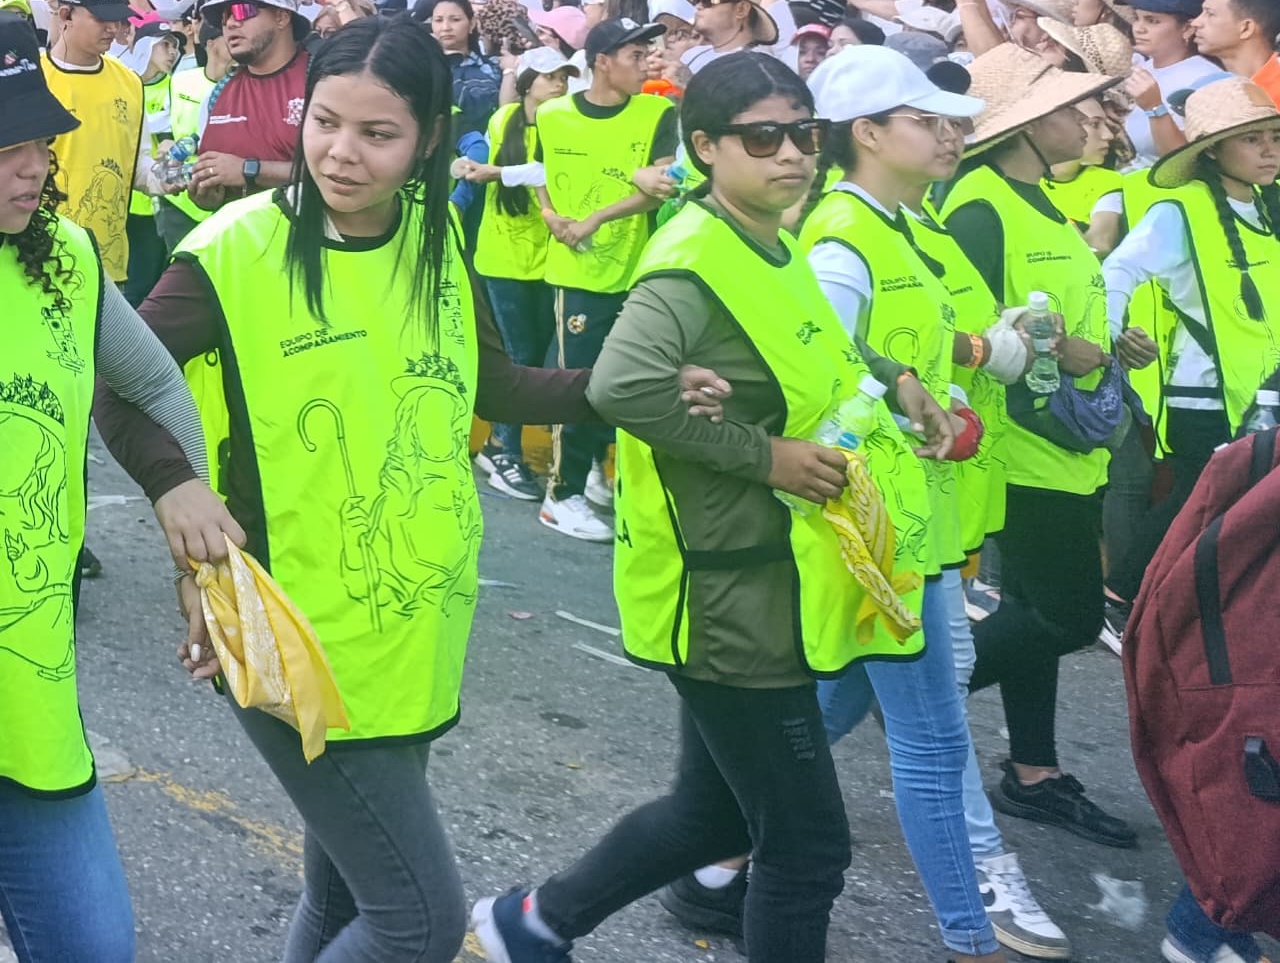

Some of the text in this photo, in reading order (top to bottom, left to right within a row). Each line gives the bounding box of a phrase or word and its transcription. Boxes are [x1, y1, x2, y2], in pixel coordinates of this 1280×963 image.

[279, 327, 328, 349] EQUIPO DE
[282, 329, 368, 358] ACOMPAÑAMIENTO
